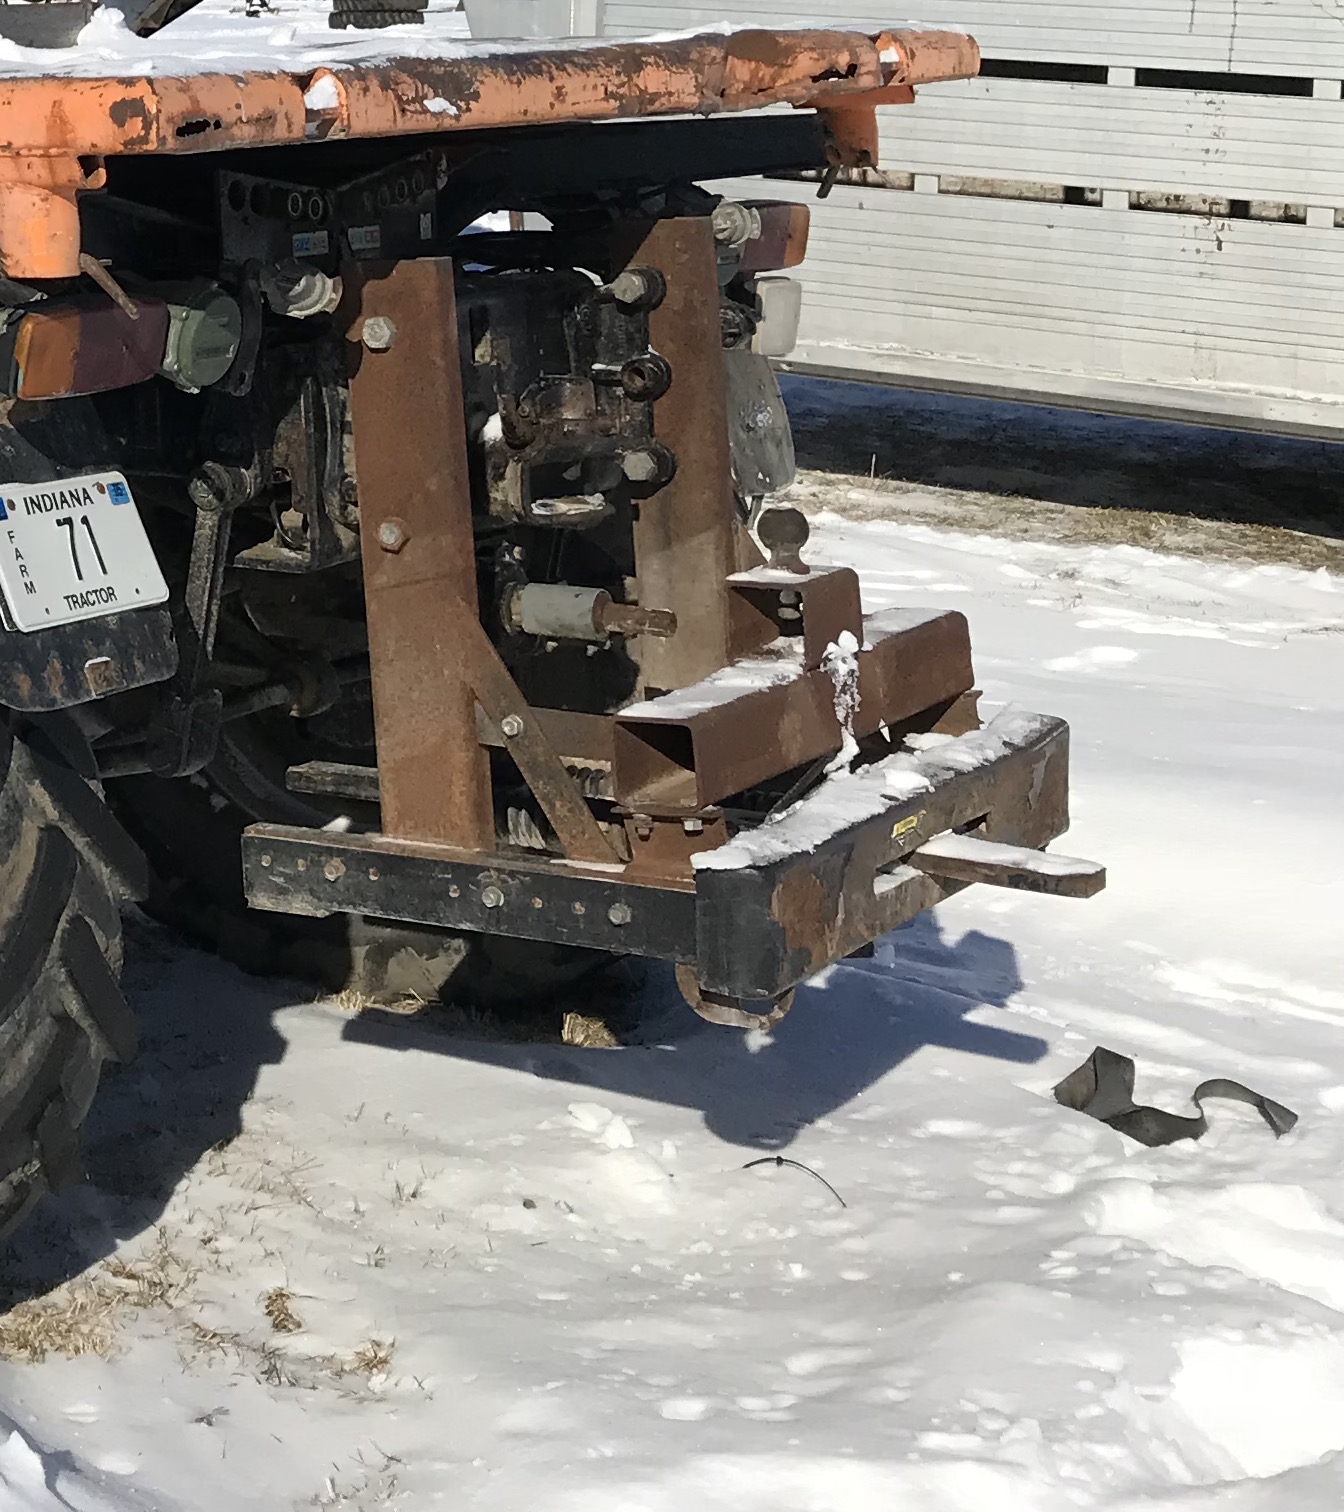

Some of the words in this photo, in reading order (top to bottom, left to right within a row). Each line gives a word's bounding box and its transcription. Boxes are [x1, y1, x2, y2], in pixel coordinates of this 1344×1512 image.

[23, 487, 94, 515] INDIANA
[7, 530, 37, 595] FARM
[56, 515, 108, 580] 71
[63, 586, 118, 611] TRACTOR
